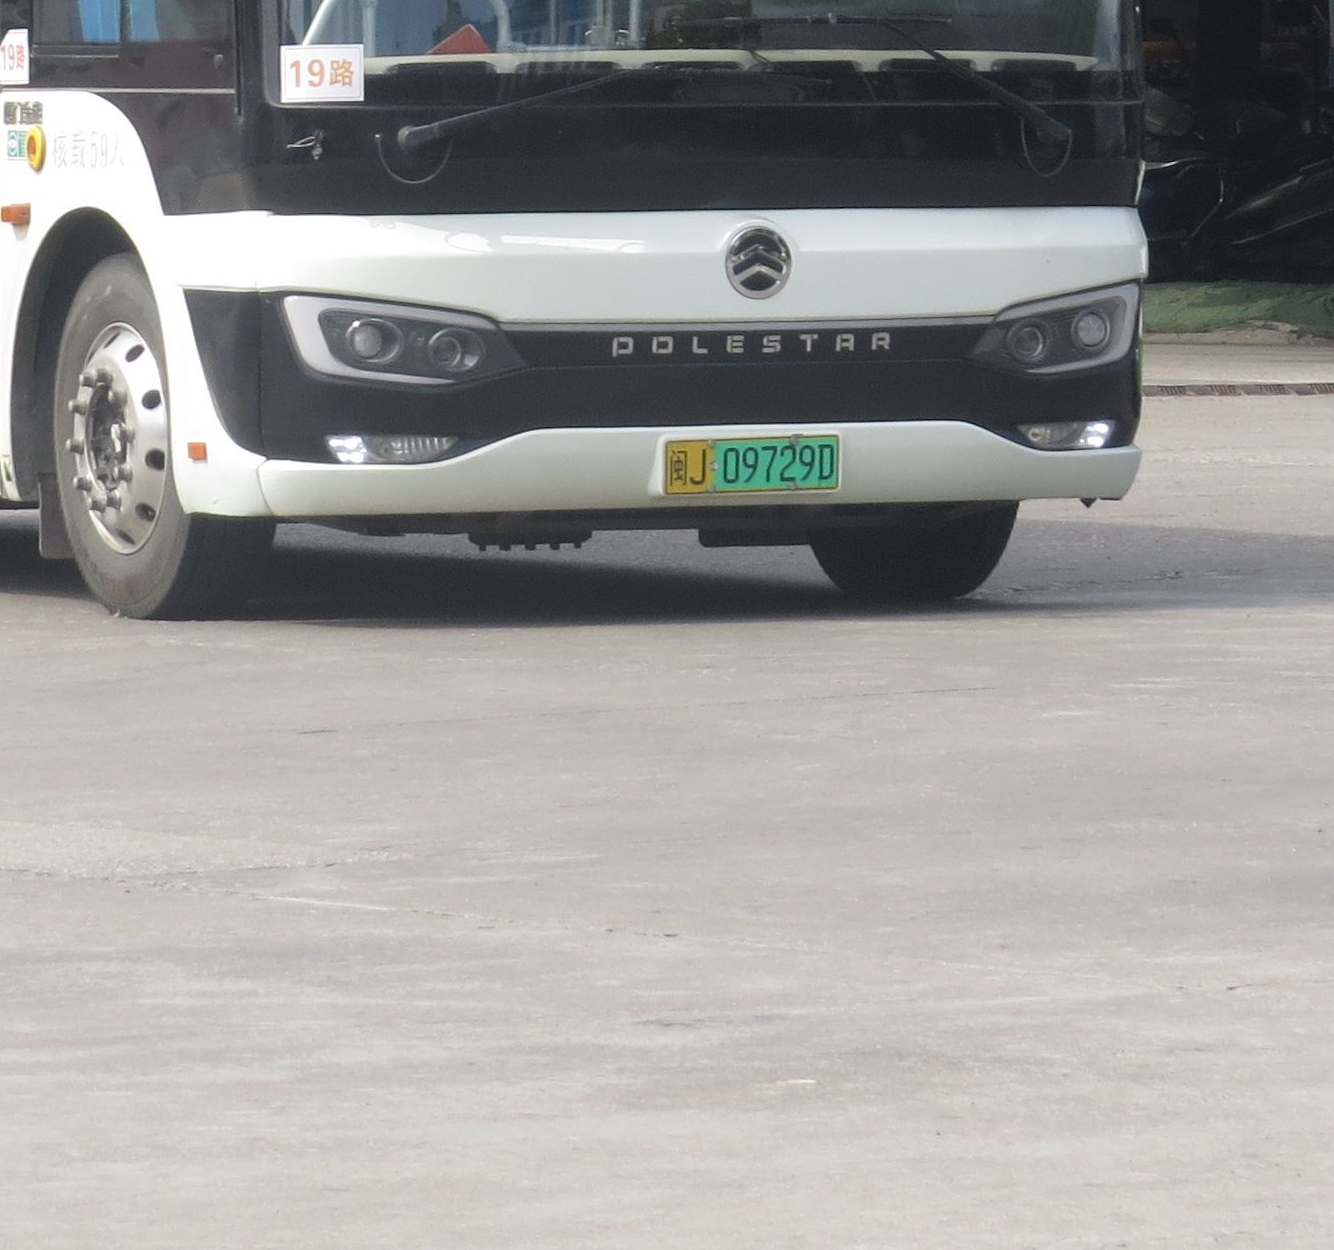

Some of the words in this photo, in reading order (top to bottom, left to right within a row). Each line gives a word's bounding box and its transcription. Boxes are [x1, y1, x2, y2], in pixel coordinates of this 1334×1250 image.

[0, 44, 25, 70] 19路
[289, 58, 356, 88] 19路
[611, 332, 891, 357] POLESTAR
[670, 447, 707, 486] 闽J
[722, 444, 835, 485] 09729D
